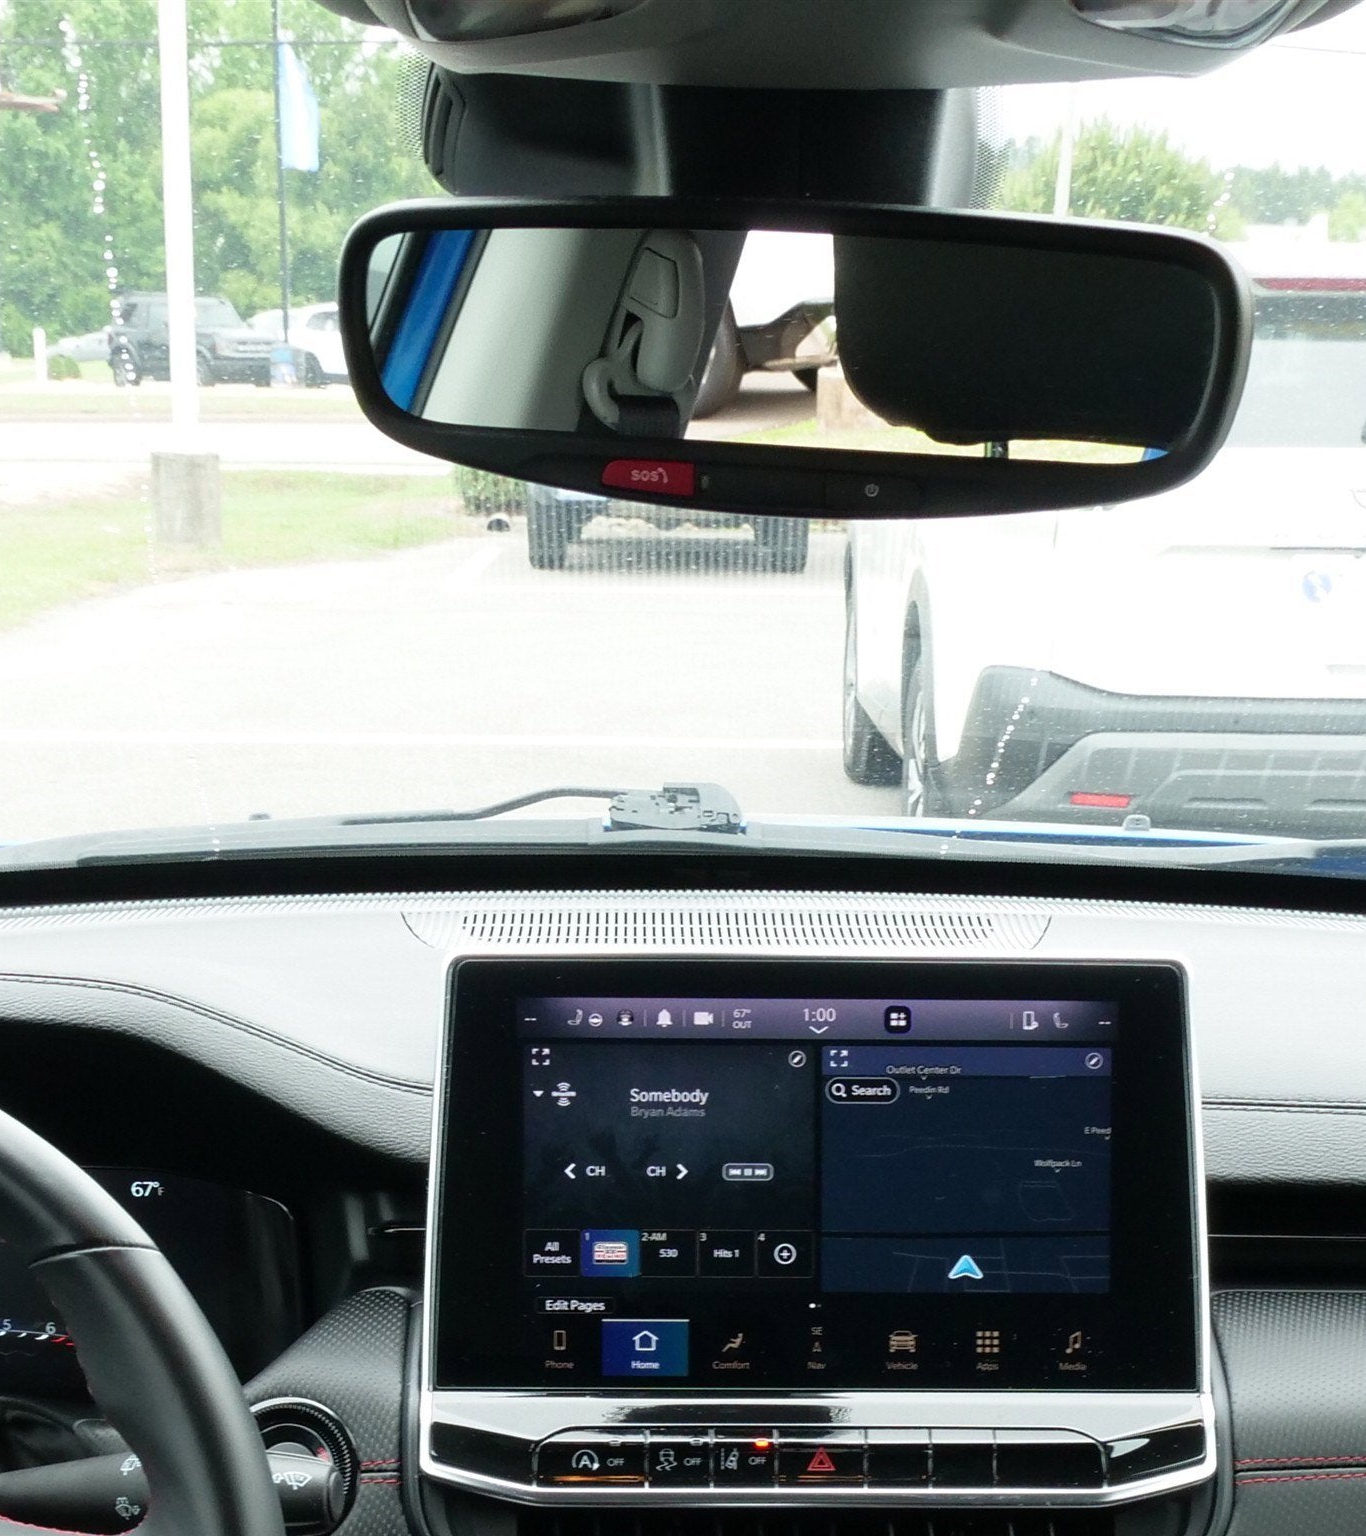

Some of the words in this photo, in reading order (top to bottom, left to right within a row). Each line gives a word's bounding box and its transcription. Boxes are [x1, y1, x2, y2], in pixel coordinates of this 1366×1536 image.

[631, 469, 659, 482] SOS
[803, 1008, 836, 1022] 1:00
[732, 1020, 752, 1029] OUT
[886, 1065, 916, 1075] Outlet
[917, 1065, 949, 1075] Center
[851, 1085, 892, 1096] Search
[629, 1088, 709, 1106] Somebody
[630, 1106, 664, 1119] Bryan
[666, 1106, 706, 1117] Adams
[585, 1165, 606, 1177] CH
[646, 1165, 667, 1177] CH
[699, 1232, 708, 1242] 3
[757, 1232, 766, 1242] 4
[544, 1242, 560, 1252] All
[713, 1248, 733, 1258] Hits
[533, 1253, 572, 1264] Presets
[545, 1299, 569, 1312] Edit
[570, 1300, 606, 1313] Pages
[2, 1318, 12, 1331] 5
[45, 1321, 56, 1334] 6
[544, 1360, 574, 1369] Phone
[631, 1360, 660, 1370] Home
[712, 1359, 750, 1370] Comfort
[887, 1360, 918, 1370] Vehicle
[976, 1361, 999, 1371] Apps
[1059, 1361, 1087, 1371] Media
[607, 1458, 625, 1468] OFF
[683, 1457, 702, 1467] OFF
[748, 1456, 767, 1466] OFF
